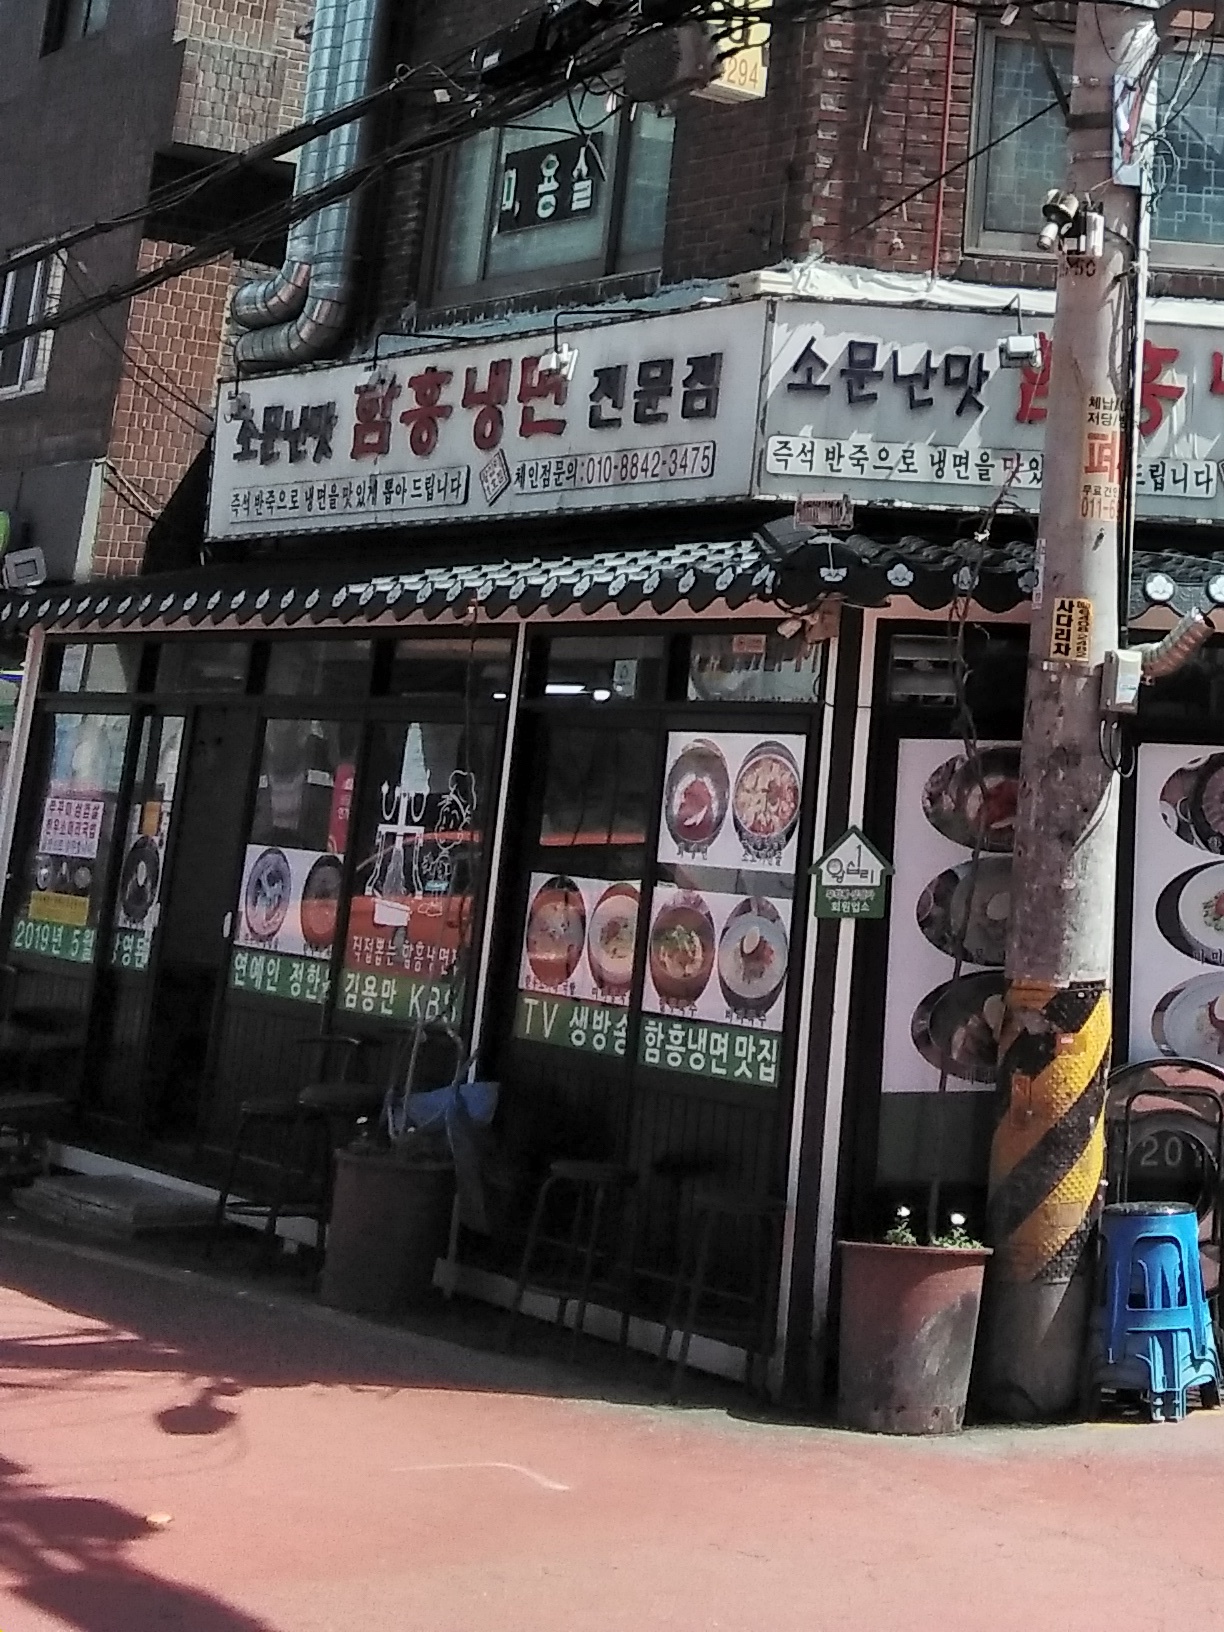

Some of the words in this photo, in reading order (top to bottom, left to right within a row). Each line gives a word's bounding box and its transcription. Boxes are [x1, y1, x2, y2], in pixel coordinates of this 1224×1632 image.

[787, 335, 991, 417] 소문난맛
[232, 401, 338, 466] 소문난맛
[350, 357, 568, 460] 함흥냉면
[588, 352, 725, 429] 전문점
[773, 440, 815, 472] 즉석
[824, 442, 918, 475] 반죽으로
[930, 448, 996, 482] 냉면을
[1136, 459, 1214, 494] 립니다
[254, 486, 300, 516] 반죽으로
[304, 483, 341, 513] 냉면을
[410, 470, 463, 502] 드립니다
[1081, 496, 1117, 519] 011-6
[826, 844, 875, 884] 왕십리
[14, 920, 64, 956] 2019년
[234, 952, 281, 992] 연예인
[289, 961, 331, 1004] 정한
[344, 972, 398, 1016] 김용만
[523, 997, 559, 1040] TV
[643, 1019, 730, 1076] 함흥냉면
[734, 1035, 779, 1084] 맛집
